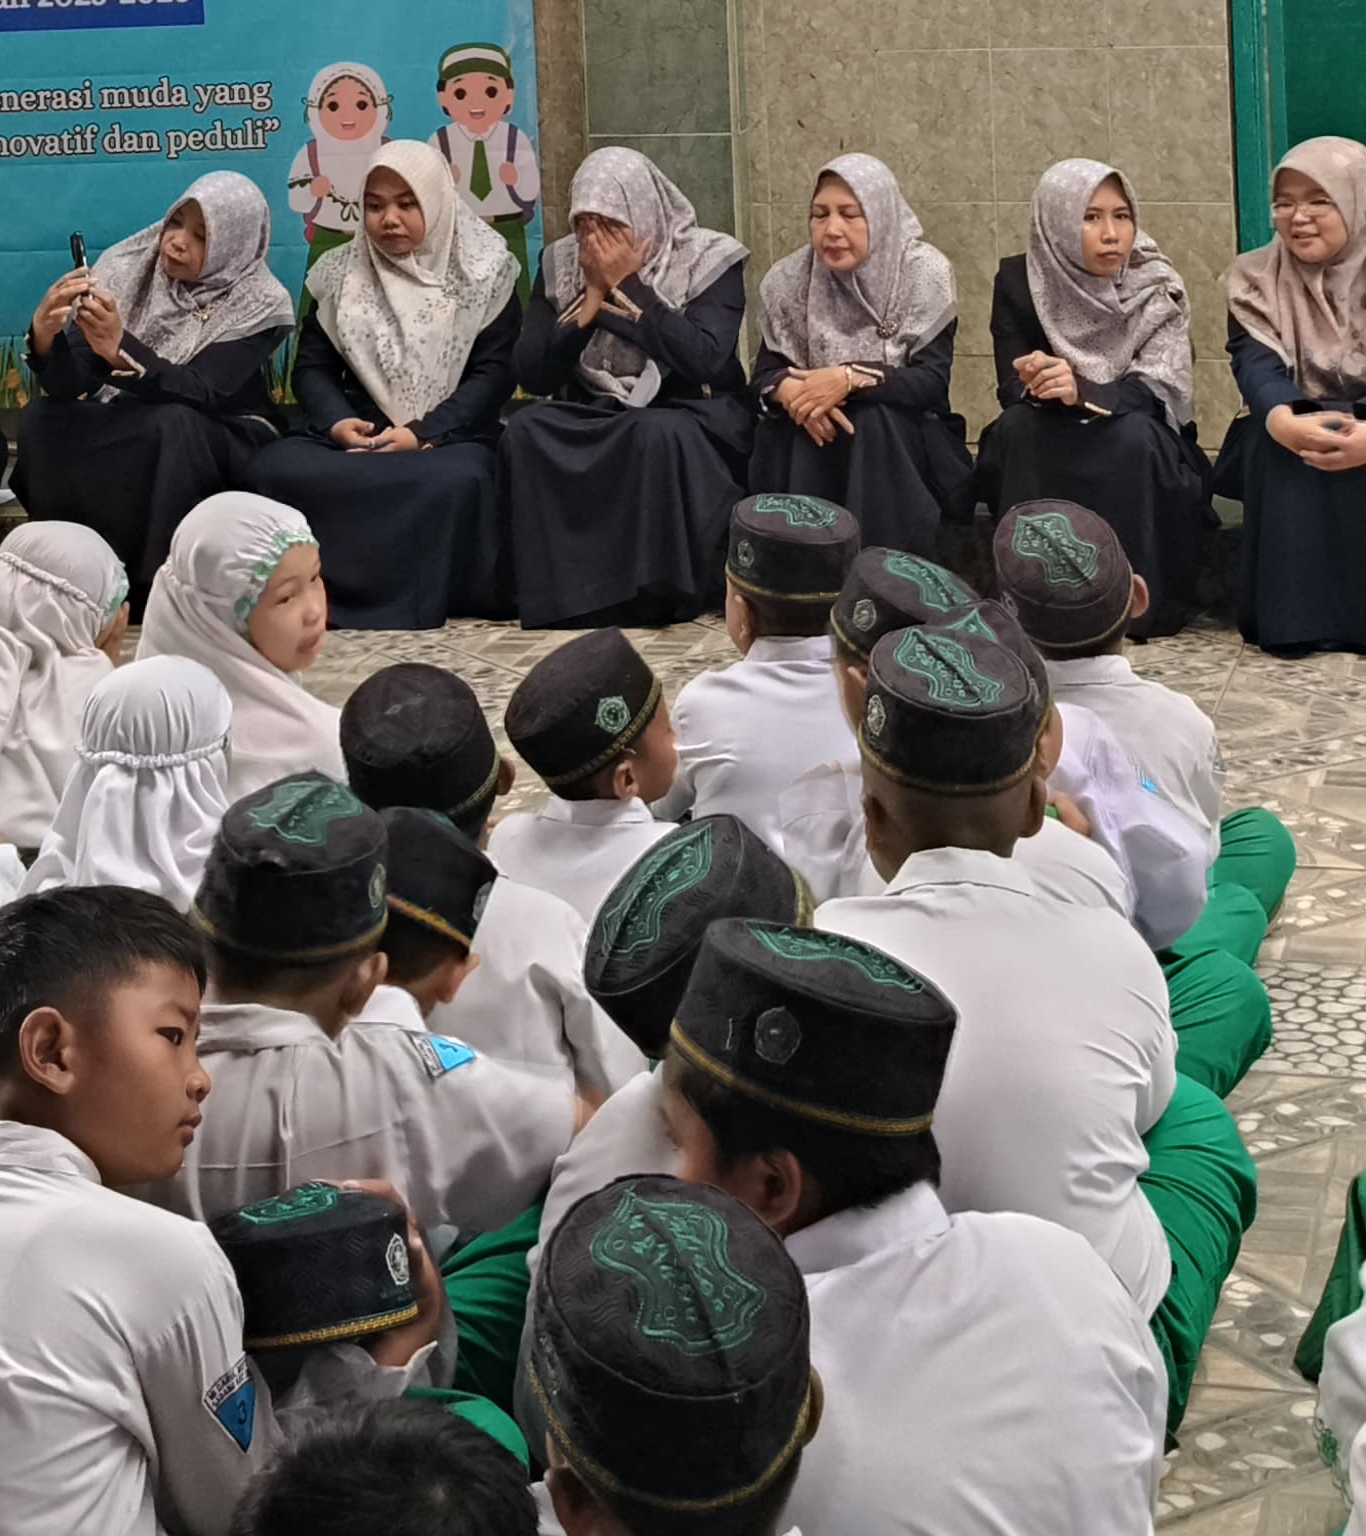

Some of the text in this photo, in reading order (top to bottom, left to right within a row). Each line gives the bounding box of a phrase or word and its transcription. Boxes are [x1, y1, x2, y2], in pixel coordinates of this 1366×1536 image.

[99, 76, 189, 110] muda
[193, 80, 273, 113] yang
[102, 121, 161, 155] dan
